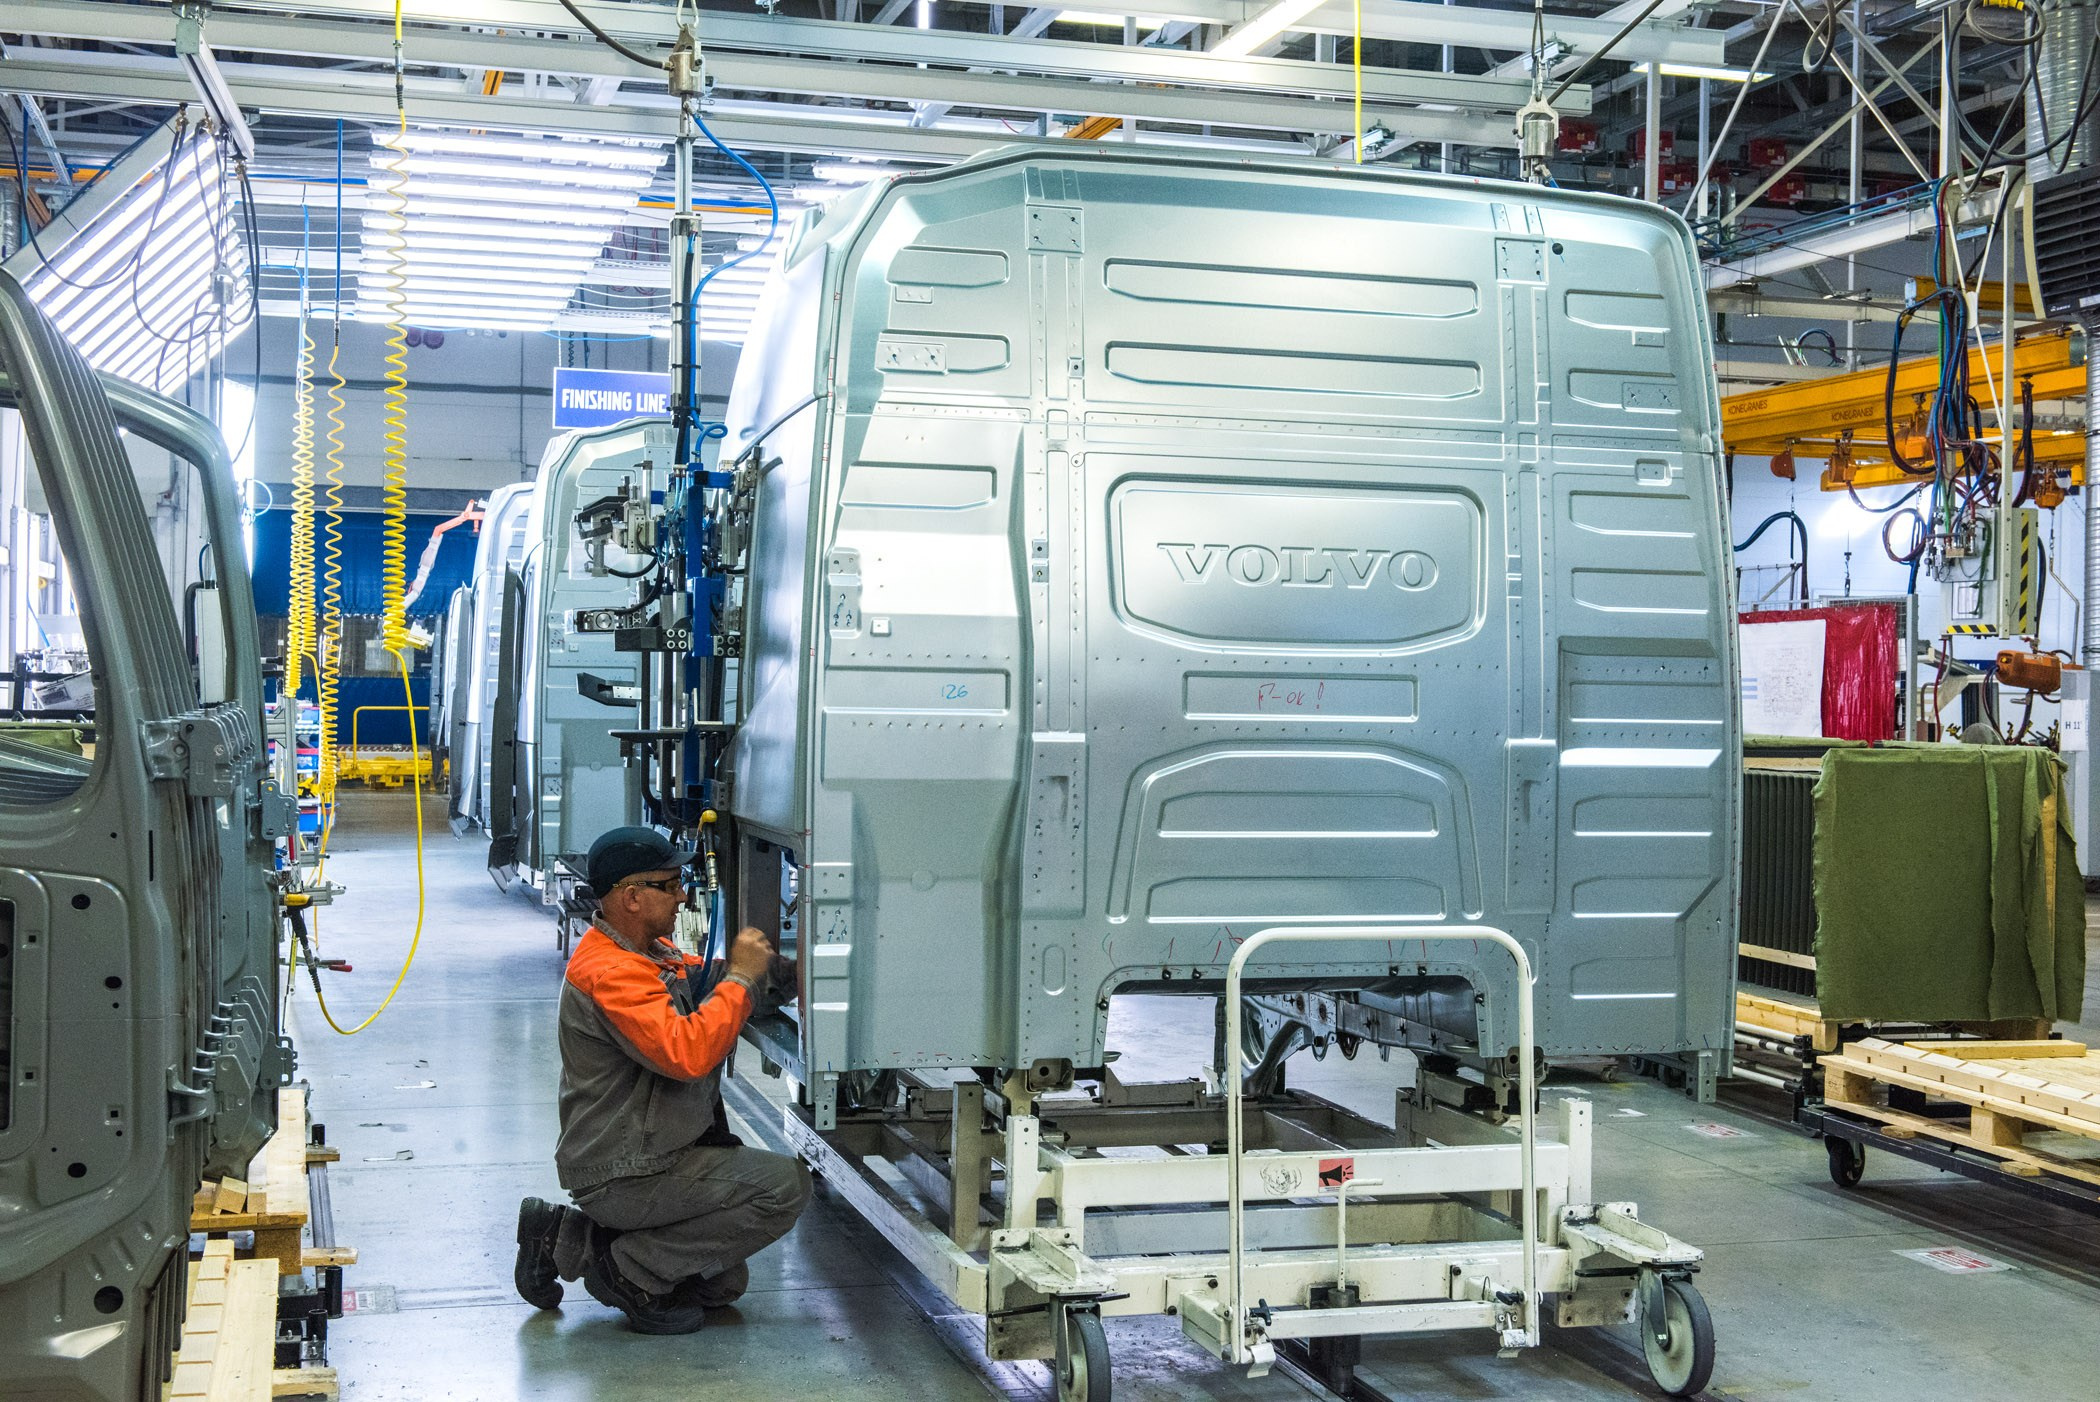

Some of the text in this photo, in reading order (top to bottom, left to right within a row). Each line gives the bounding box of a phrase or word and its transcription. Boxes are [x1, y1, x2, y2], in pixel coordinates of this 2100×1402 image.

[561, 388, 667, 413] FINISHING LINE
[1157, 543, 1439, 592] VOLVO
[941, 684, 969, 699] 126
